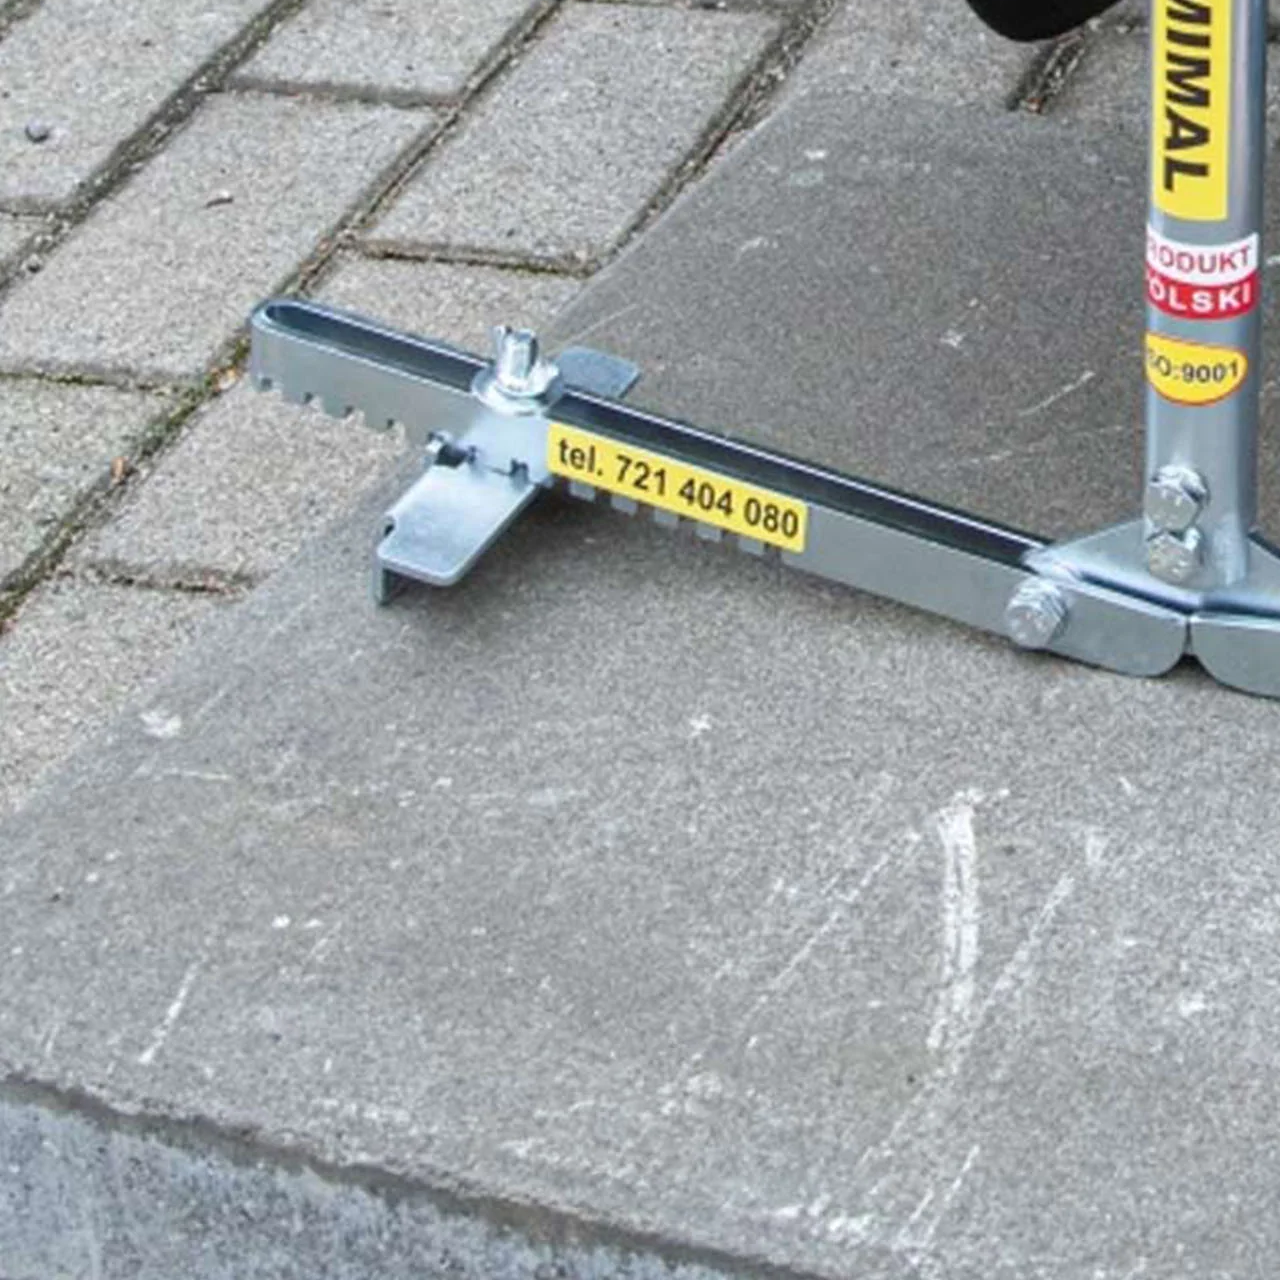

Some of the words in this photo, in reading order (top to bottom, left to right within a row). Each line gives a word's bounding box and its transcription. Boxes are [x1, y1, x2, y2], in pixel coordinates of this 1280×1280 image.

[1146, 269, 1251, 313] OLSKI
[558, 438, 603, 477] tel.
[615, 454, 667, 496] 721
[679, 477, 733, 519] 404
[744, 497, 799, 538] 080
